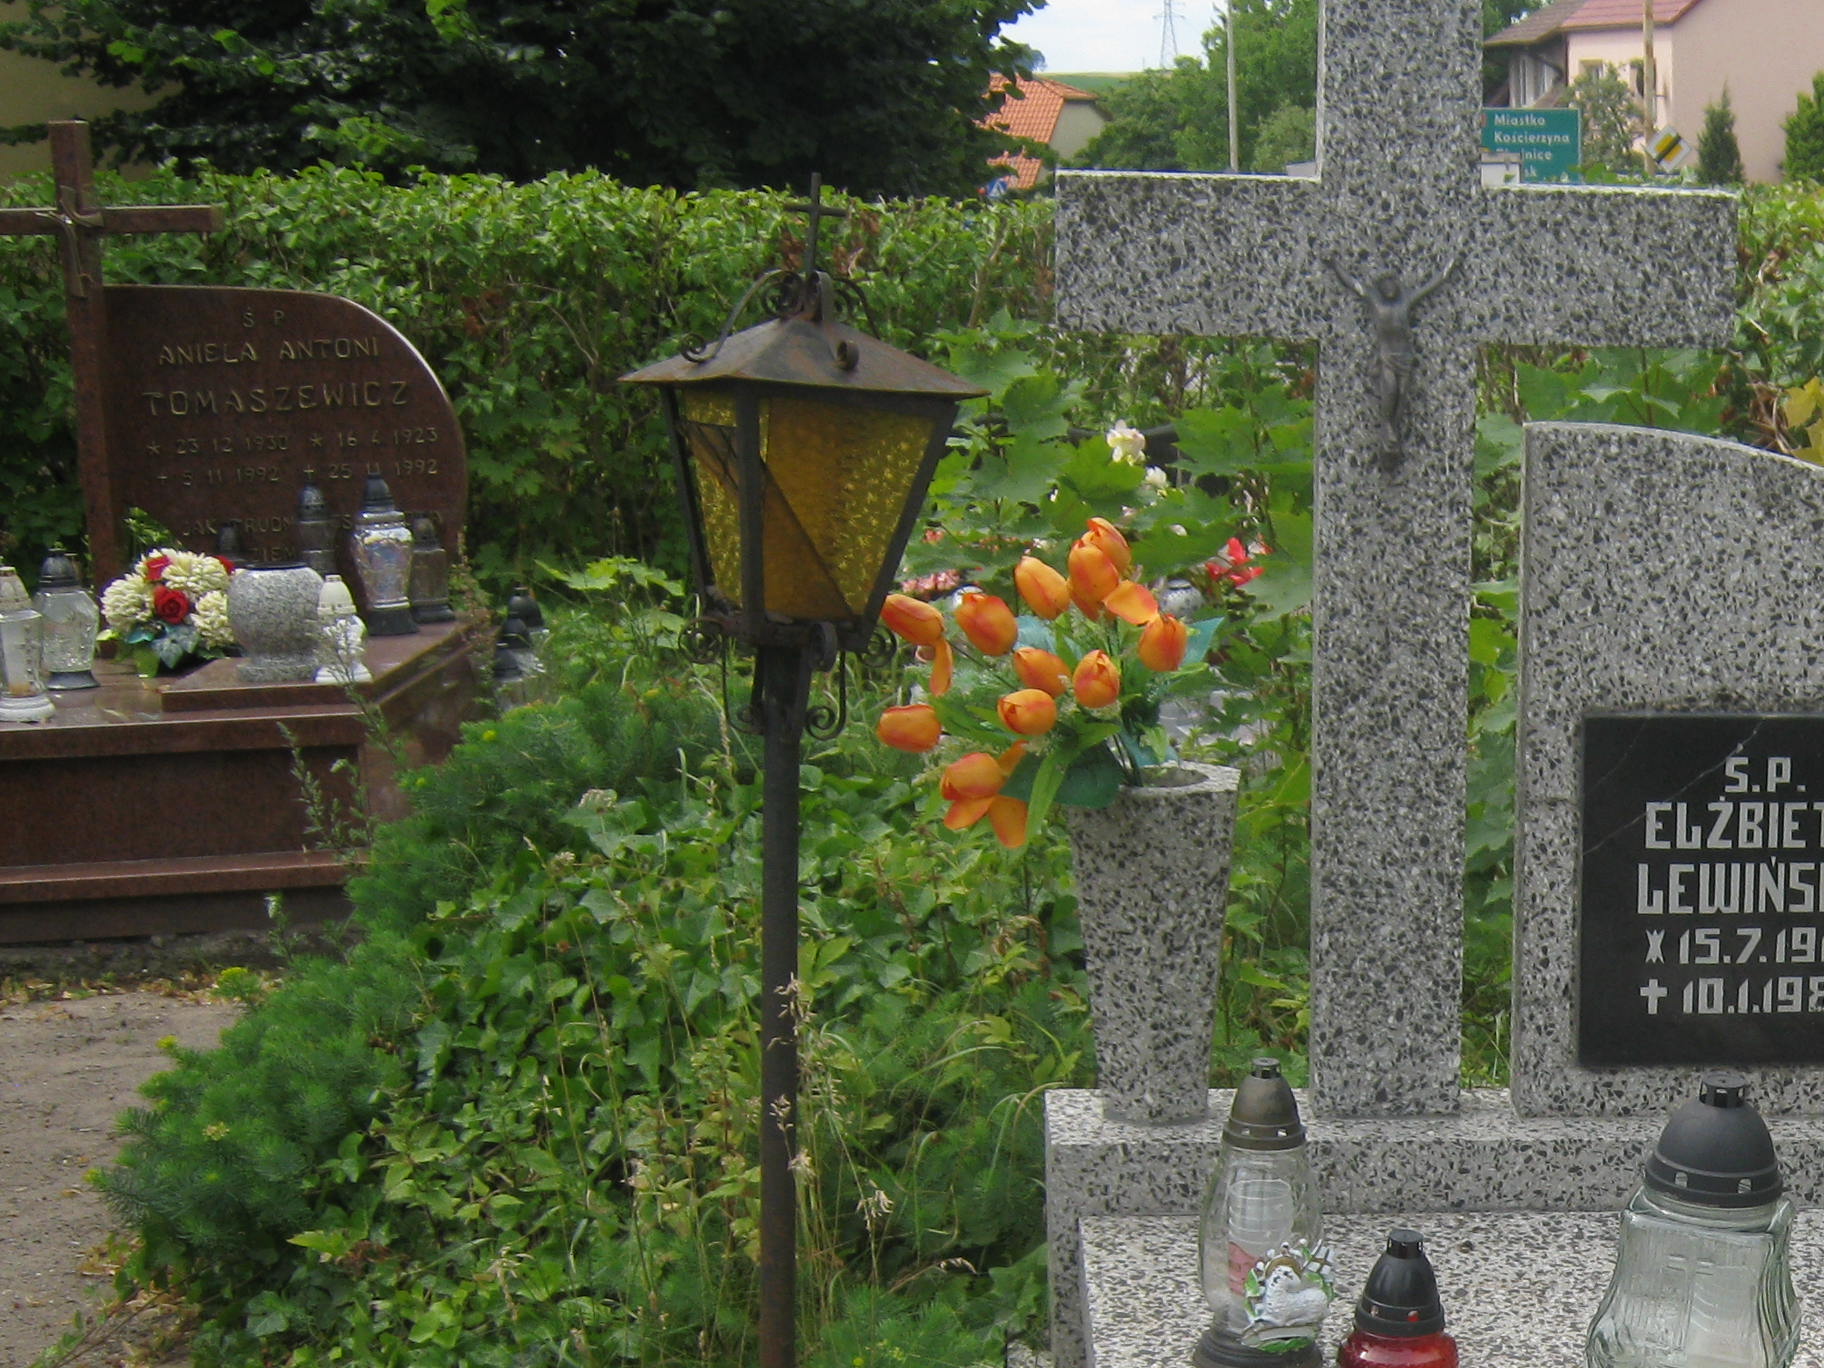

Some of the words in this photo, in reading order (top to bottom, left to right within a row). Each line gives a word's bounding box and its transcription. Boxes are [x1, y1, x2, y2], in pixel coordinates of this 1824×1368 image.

[1494, 114, 1546, 126] Miastko
[1494, 131, 1570, 146] Kościerzyna
[159, 342, 258, 365] ANIELA
[279, 336, 378, 361] ANTONI
[141, 381, 408, 416] TOMASZEWICZ
[212, 437, 232, 453] 12
[393, 427, 438, 445] 1923
